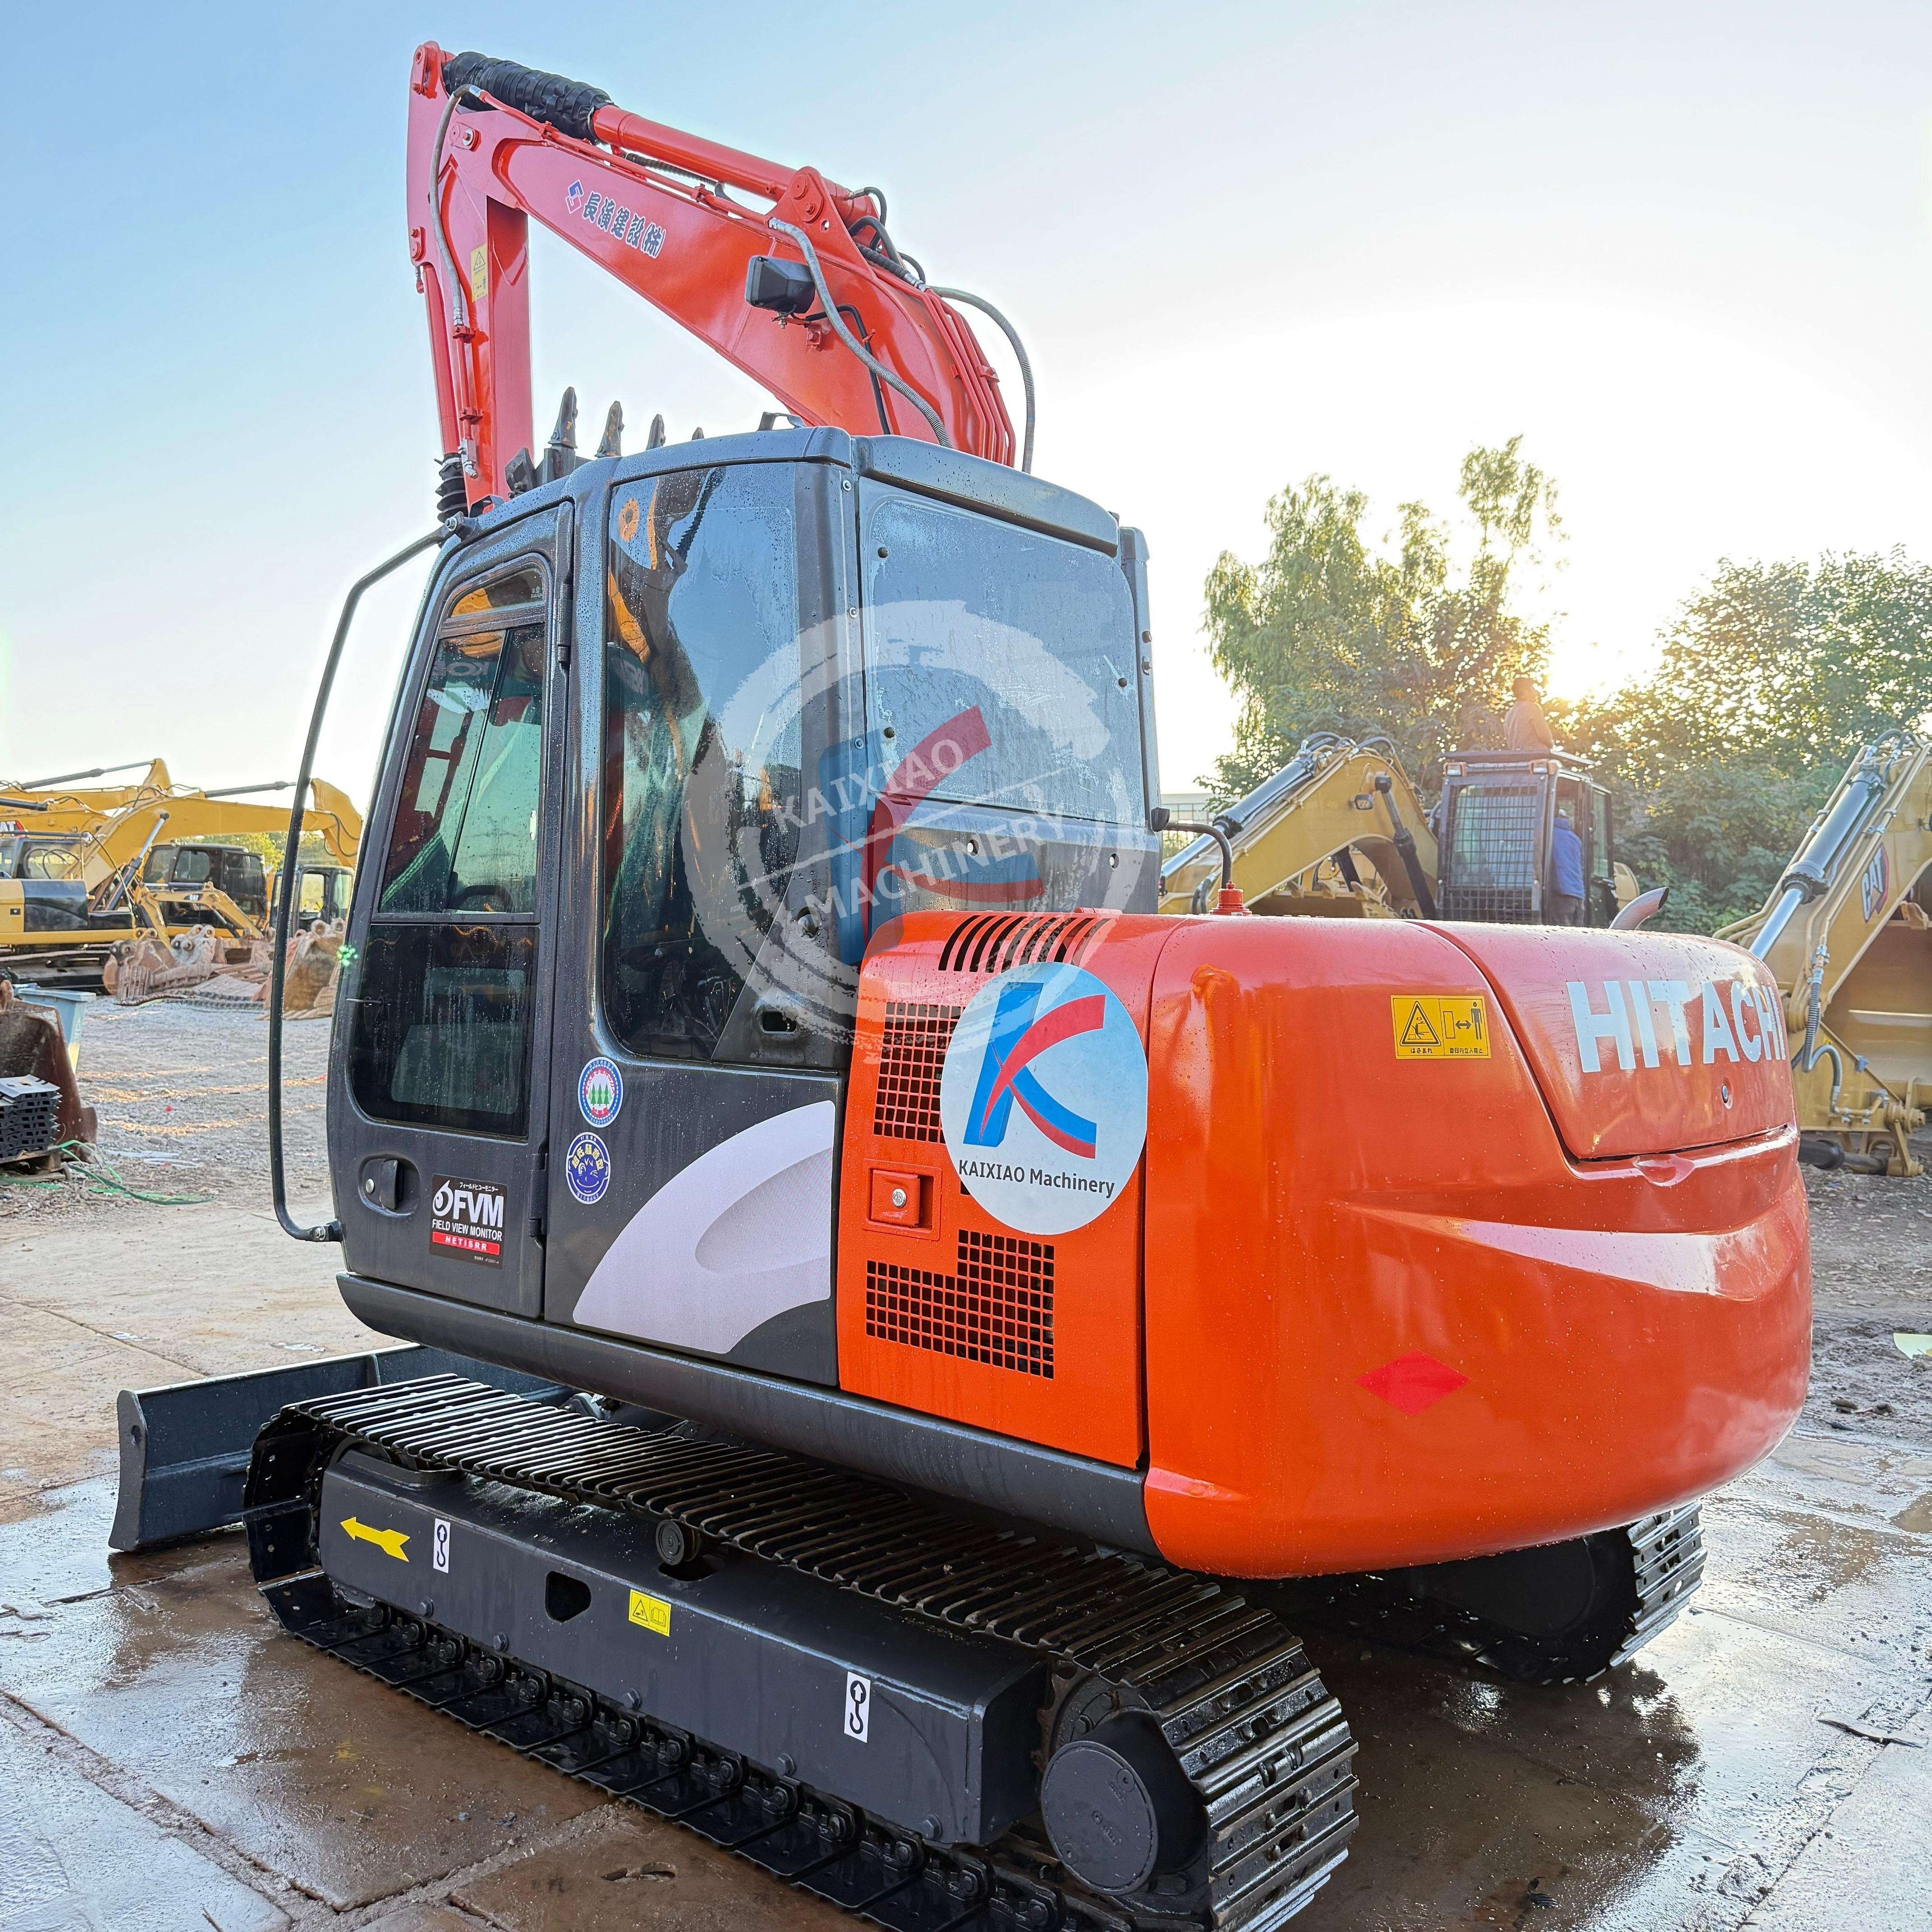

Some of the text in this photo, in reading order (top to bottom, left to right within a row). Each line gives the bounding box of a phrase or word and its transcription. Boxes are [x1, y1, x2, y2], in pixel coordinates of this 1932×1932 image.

[1566, 980, 1786, 1073] HITACHI
[958, 1159, 1115, 1199] KAIXIAO Machinery
[453, 1189, 504, 1228] FVM
[432, 1219, 503, 1242] FIELD VIEW MONITOR
